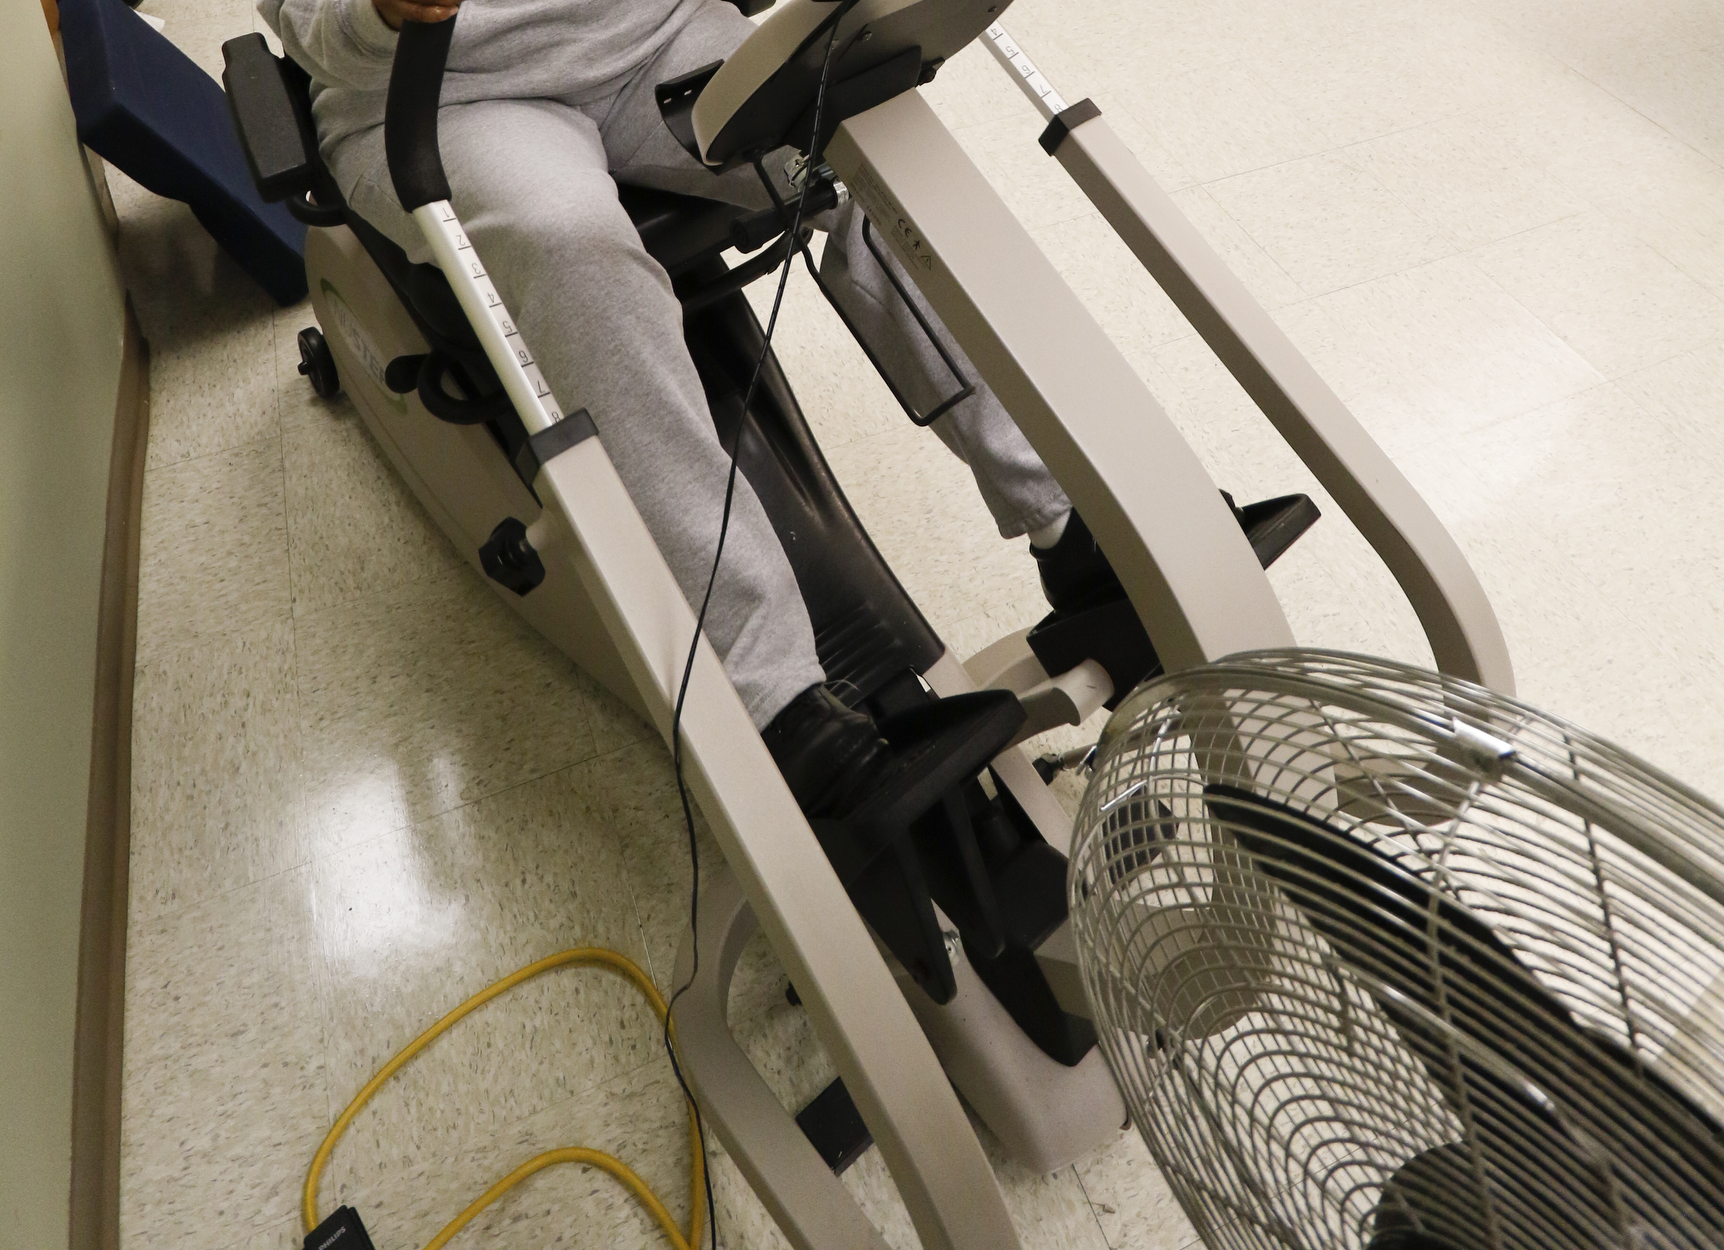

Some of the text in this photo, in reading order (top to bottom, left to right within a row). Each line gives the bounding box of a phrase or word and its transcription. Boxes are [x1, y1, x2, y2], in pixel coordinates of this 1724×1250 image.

[456, 234, 467, 246] 2
[471, 262, 482, 275] 3
[487, 291, 496, 303] 4
[502, 321, 513, 334] 5
[518, 350, 530, 363] 6
[536, 380, 546, 393] 7
[551, 411, 563, 423] 8
[318, 1226, 347, 1250] PHILIPS
